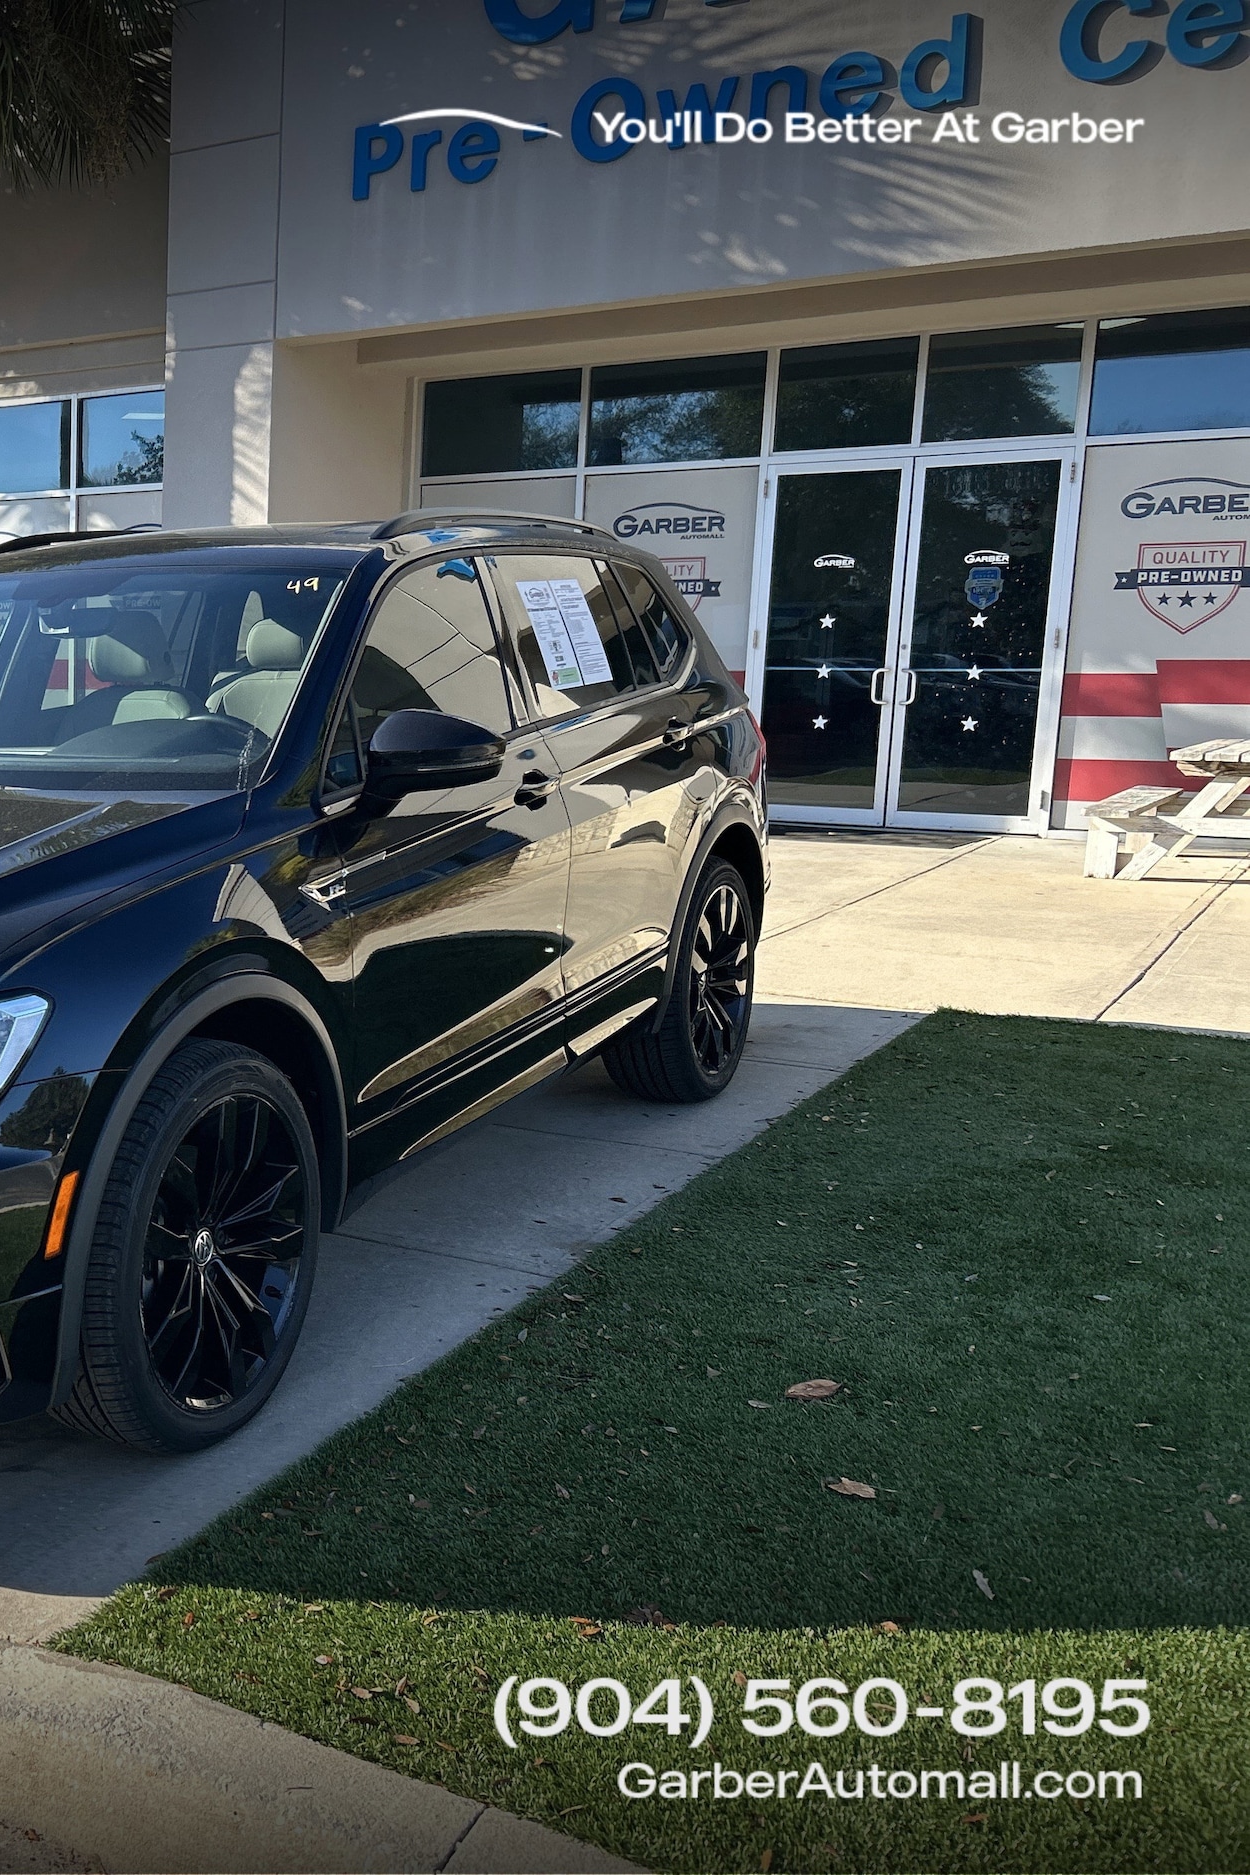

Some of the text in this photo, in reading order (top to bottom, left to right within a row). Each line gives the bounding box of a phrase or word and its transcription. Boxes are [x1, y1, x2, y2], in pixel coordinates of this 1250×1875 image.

[613, 514, 725, 538] GARBER
[963, 554, 1010, 565] GARBER
[1152, 550, 1230, 565] QUALITY
[1137, 569, 1243, 584] PRE-OWNED
